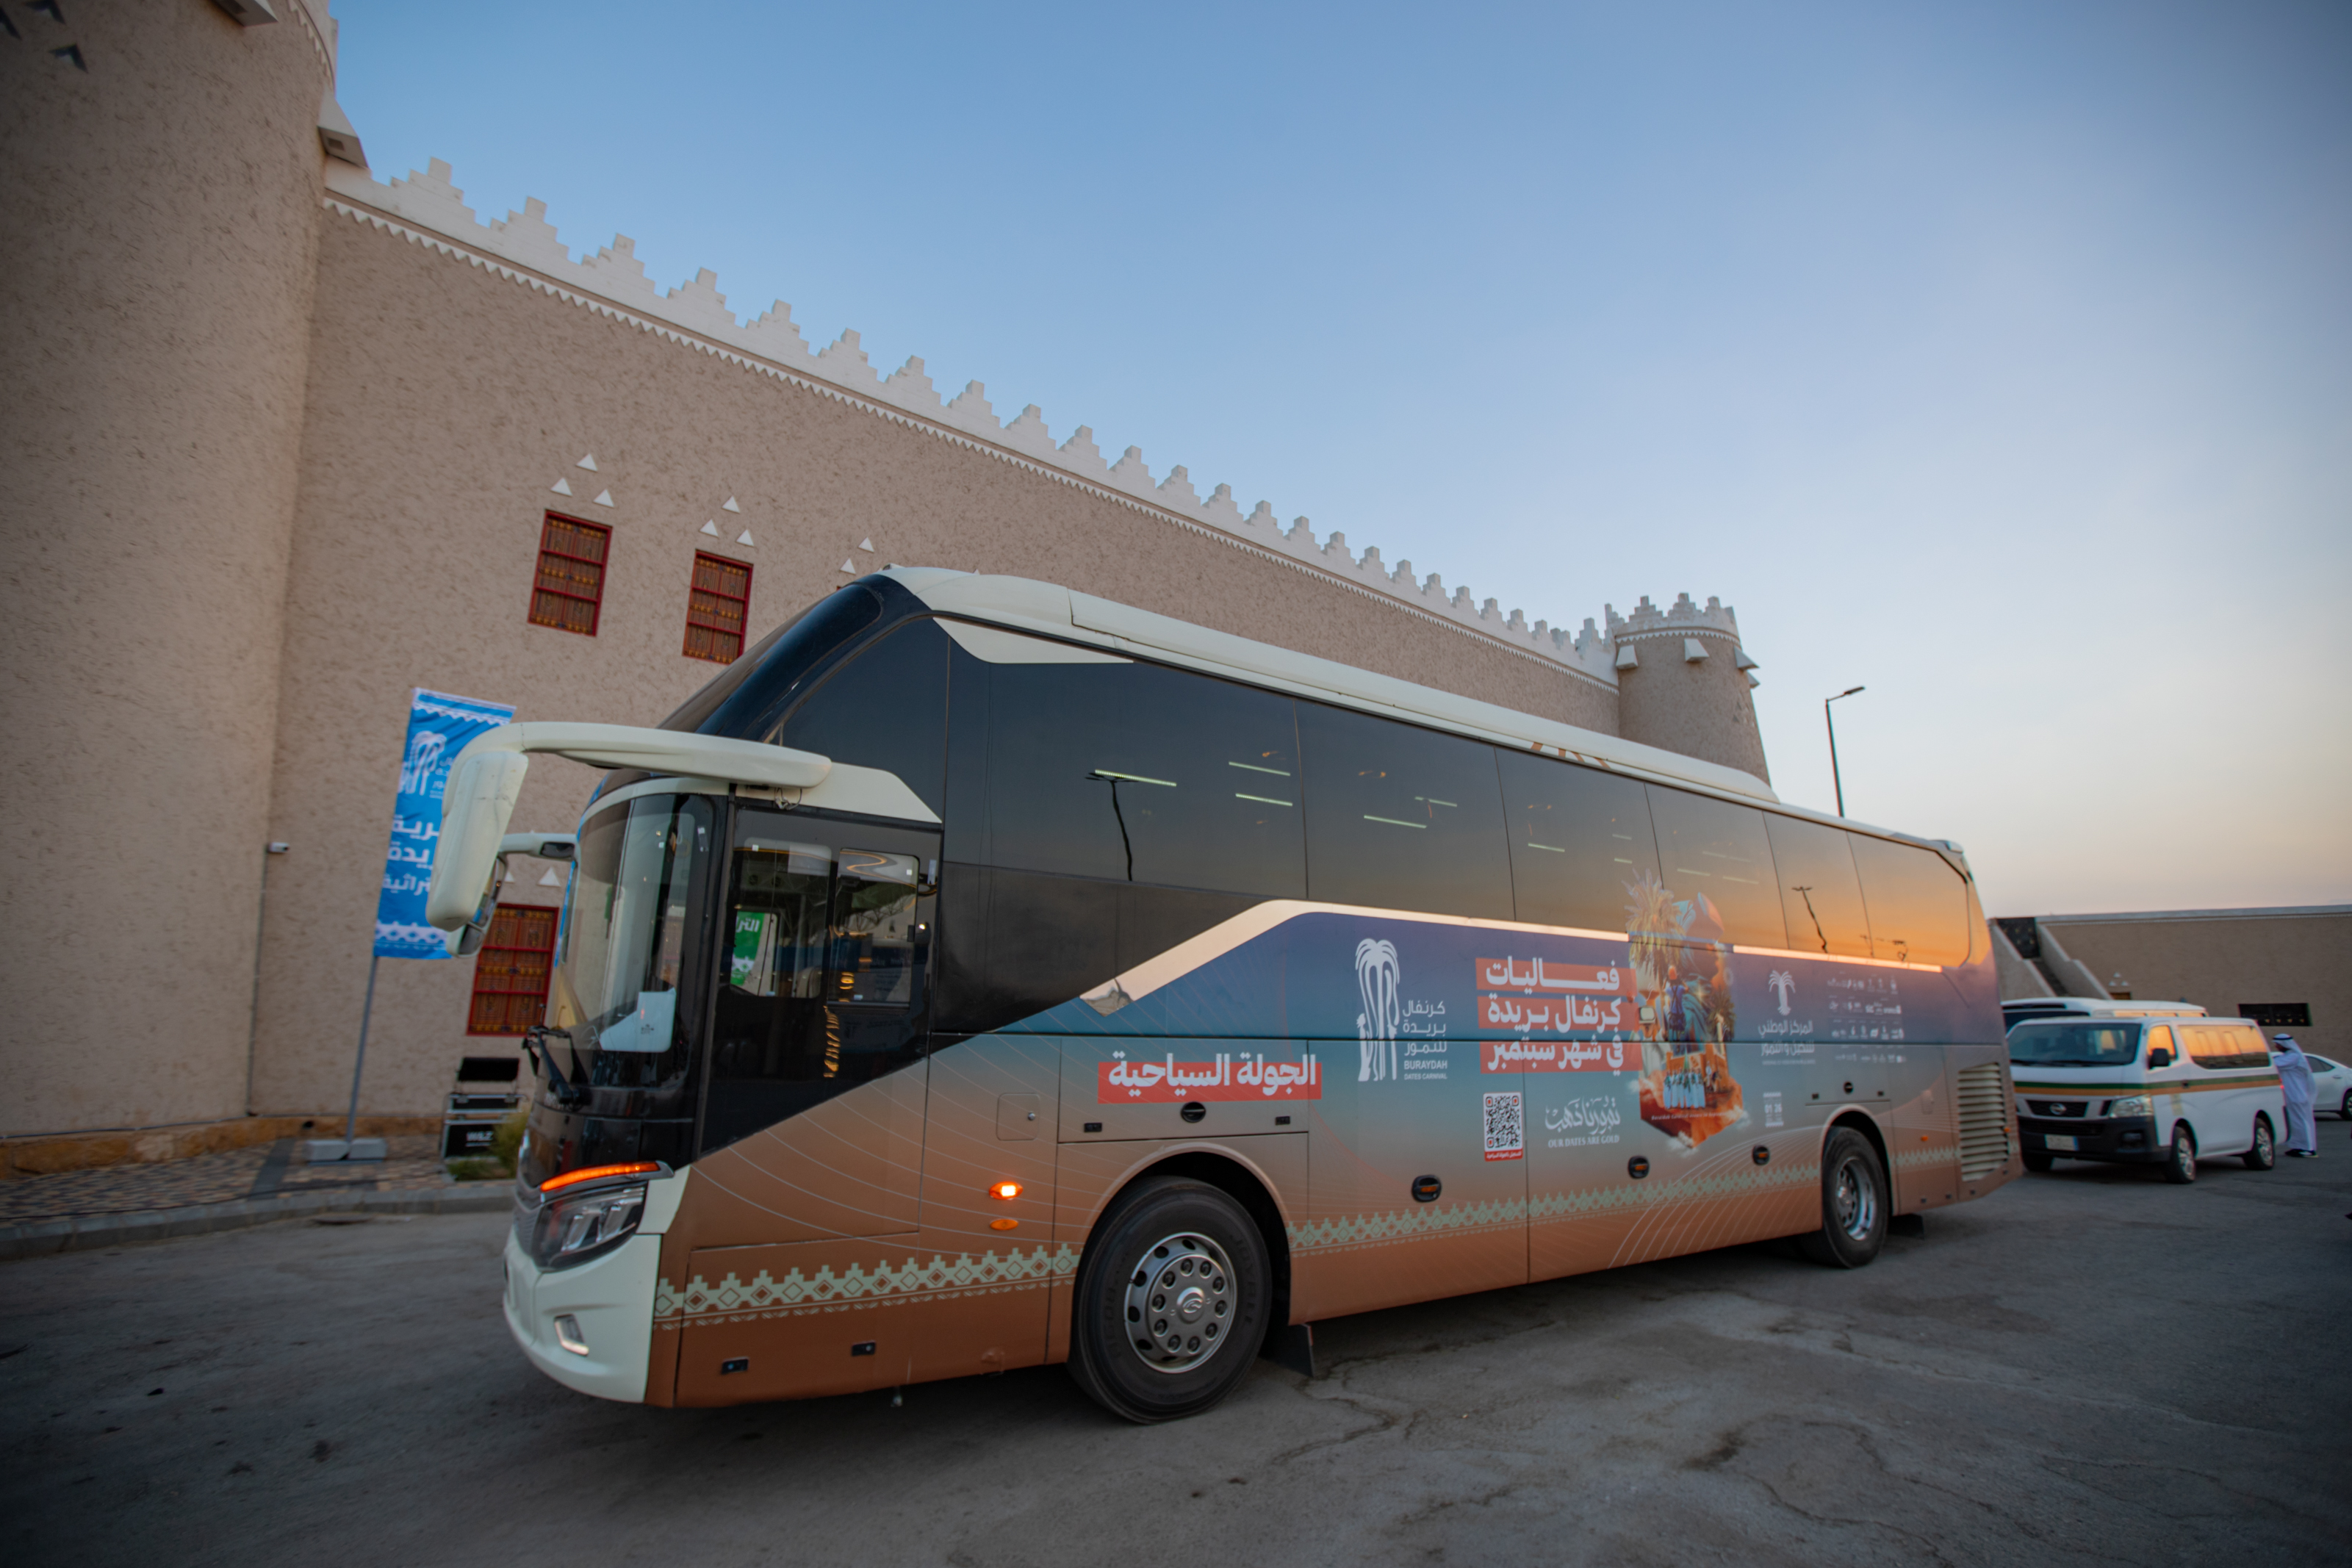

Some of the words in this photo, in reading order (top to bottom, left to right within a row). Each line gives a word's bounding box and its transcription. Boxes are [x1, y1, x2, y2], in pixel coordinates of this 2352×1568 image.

[1486, 956, 1620, 994] فعاليات
[1402, 1000, 1445, 1018] كرنفال
[1488, 993, 1549, 1032] بريدة
[1555, 995, 1622, 1034] كرنفال
[1402, 1019, 1446, 1037] بريدة
[1404, 1060, 1447, 1070] BURAYDAH
[1487, 1037, 1556, 1071] سبتمبر
[1558, 1035, 1603, 1069] شهر
[1606, 1030, 1624, 1076] في
[1108, 1051, 1231, 1096] السياحية
[1237, 1052, 1316, 1096] الجولة
[1548, 1139, 1564, 1148] OUR
[1564, 1137, 1586, 1147] DATES
[1587, 1135, 1600, 1145] ARE
[1601, 1134, 1619, 1144] GOLD
